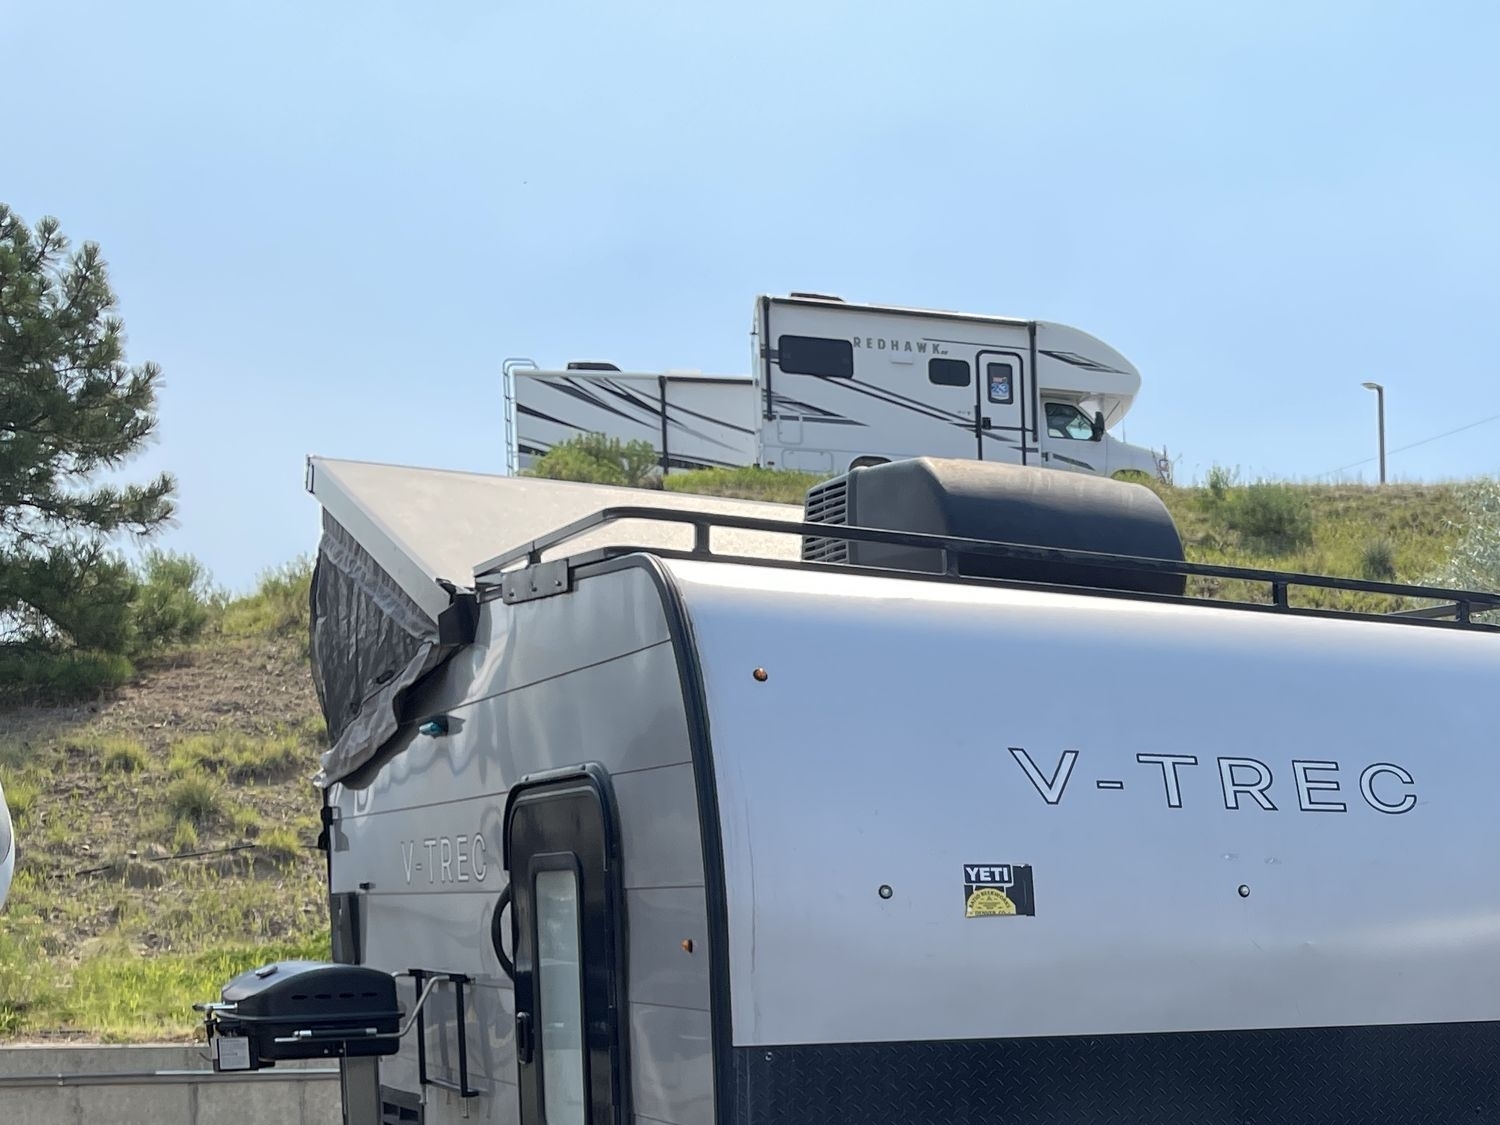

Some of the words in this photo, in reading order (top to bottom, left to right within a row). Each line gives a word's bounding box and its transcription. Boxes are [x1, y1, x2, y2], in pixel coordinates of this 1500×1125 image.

[853, 336, 941, 355] REDHAWK
[1008, 747, 1417, 814] V-TREC
[400, 832, 487, 885] V-TREC
[965, 867, 1008, 881] YETI
